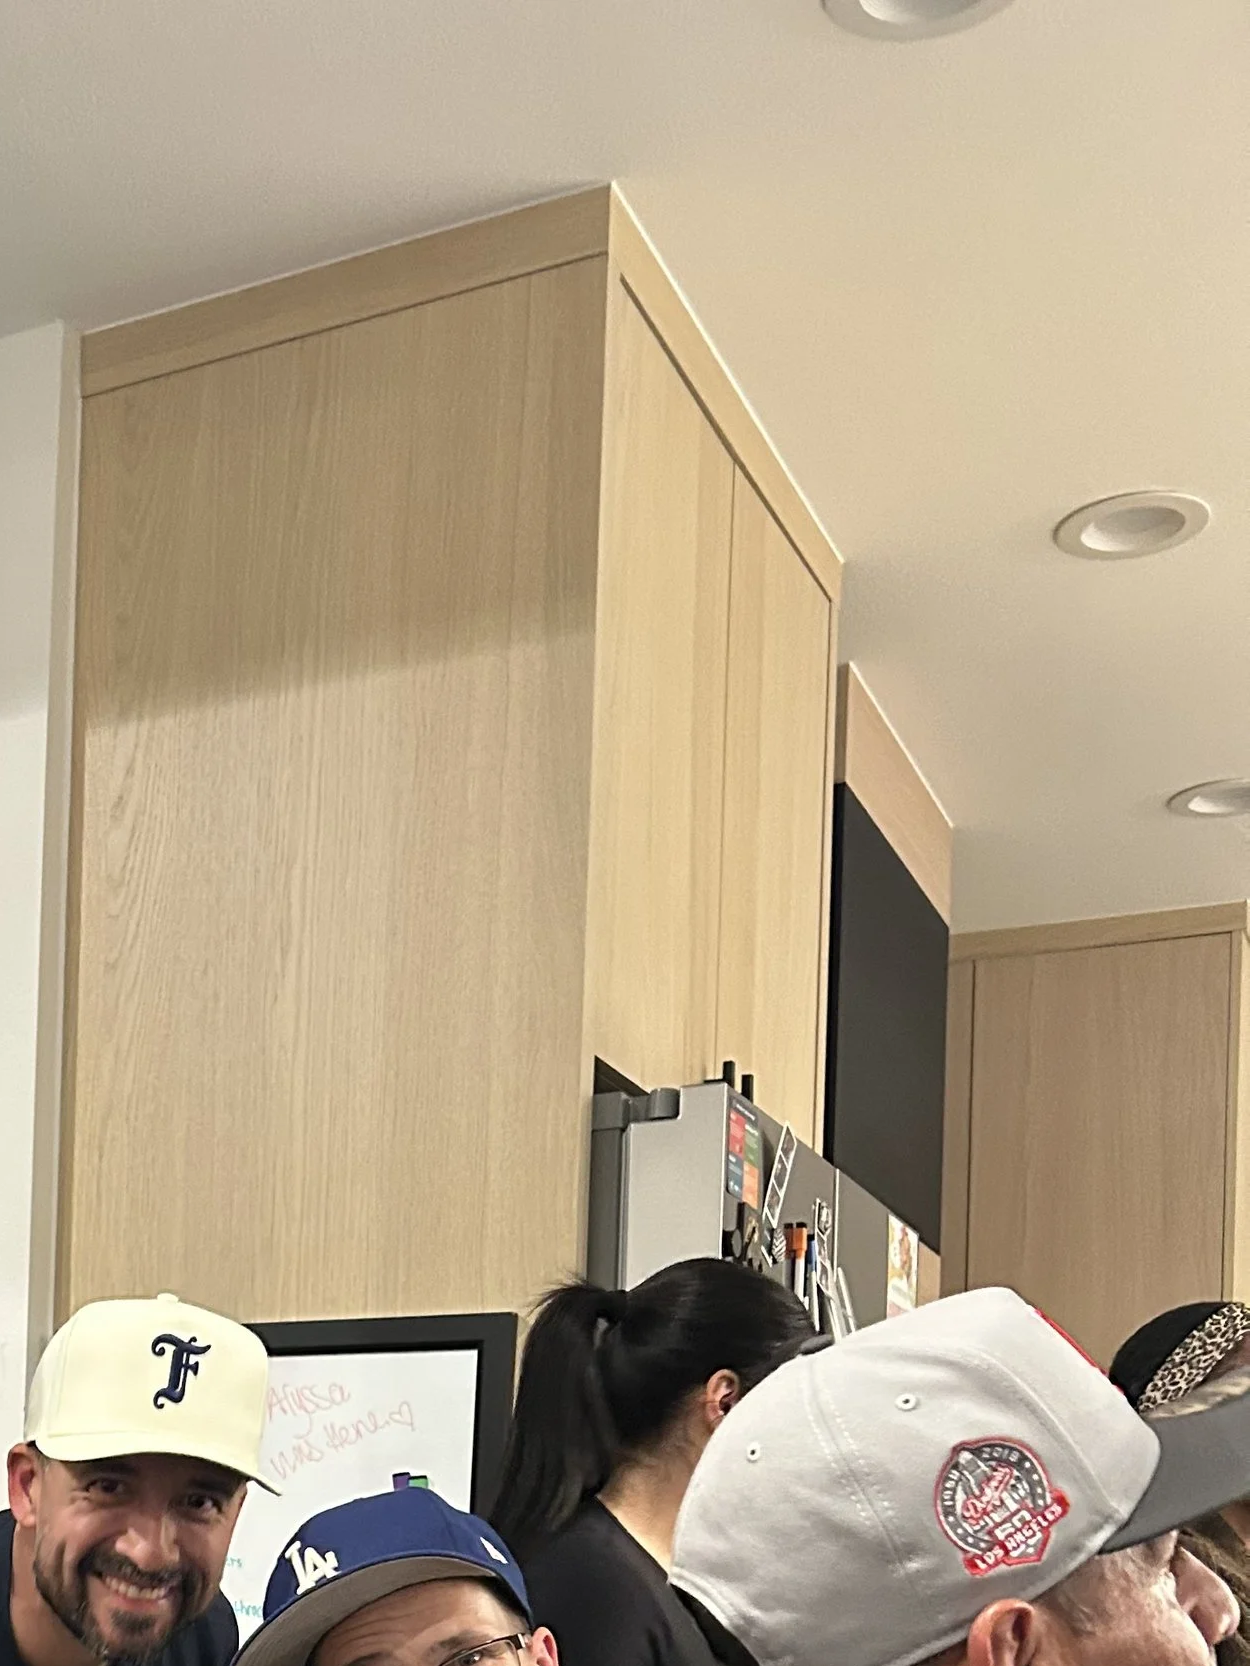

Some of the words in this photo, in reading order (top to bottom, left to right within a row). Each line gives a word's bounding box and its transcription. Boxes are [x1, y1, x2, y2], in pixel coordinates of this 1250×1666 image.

[266, 1382, 351, 1439] Alyssa
[269, 1438, 324, 1480] was
[284, 1540, 340, 1596] LA
[974, 1545, 1005, 1570] LOS
